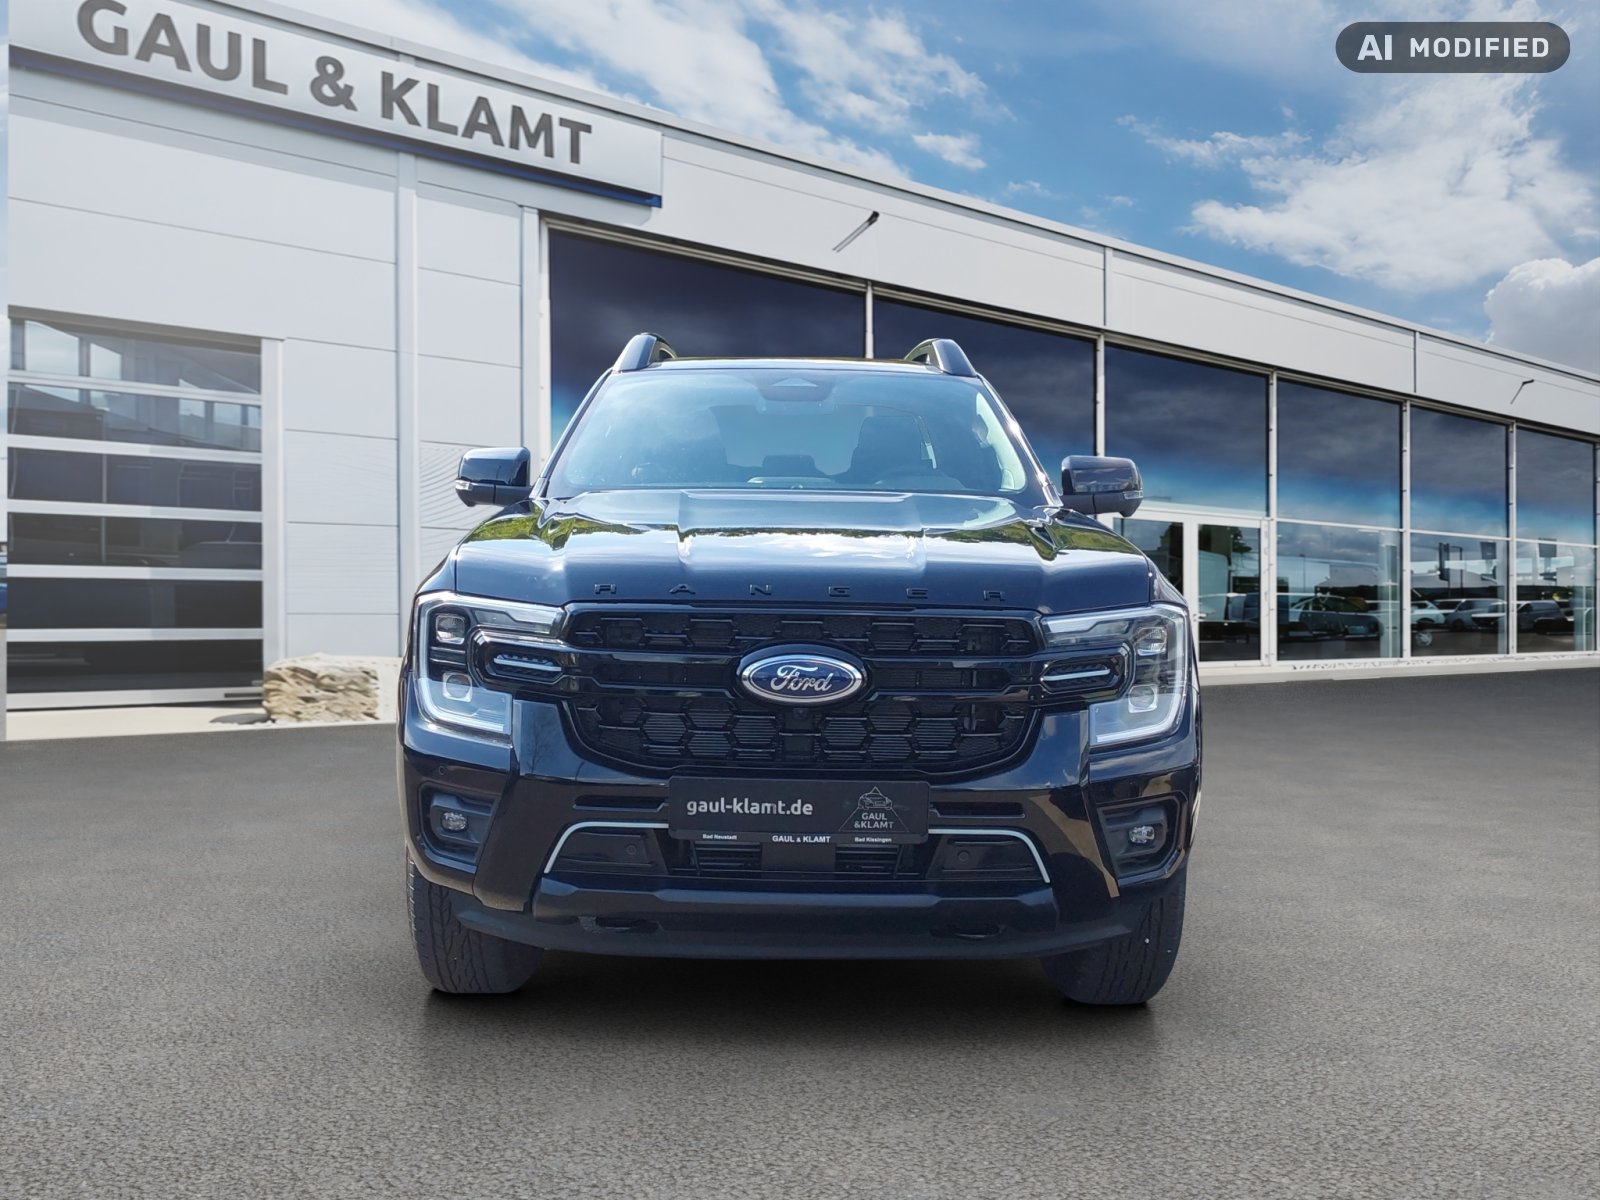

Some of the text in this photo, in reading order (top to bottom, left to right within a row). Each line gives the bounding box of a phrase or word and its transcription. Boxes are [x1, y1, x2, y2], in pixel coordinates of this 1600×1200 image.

[77, 0, 593, 165] GAUL & KLAMT
[770, 664, 832, 692] Ford
[686, 797, 813, 816] gaul-klamt.de
[861, 812, 888, 821] GAUL
[854, 820, 895, 829] &KLAMT
[772, 835, 795, 843] GAUL
[803, 835, 831, 844] KLAMT
